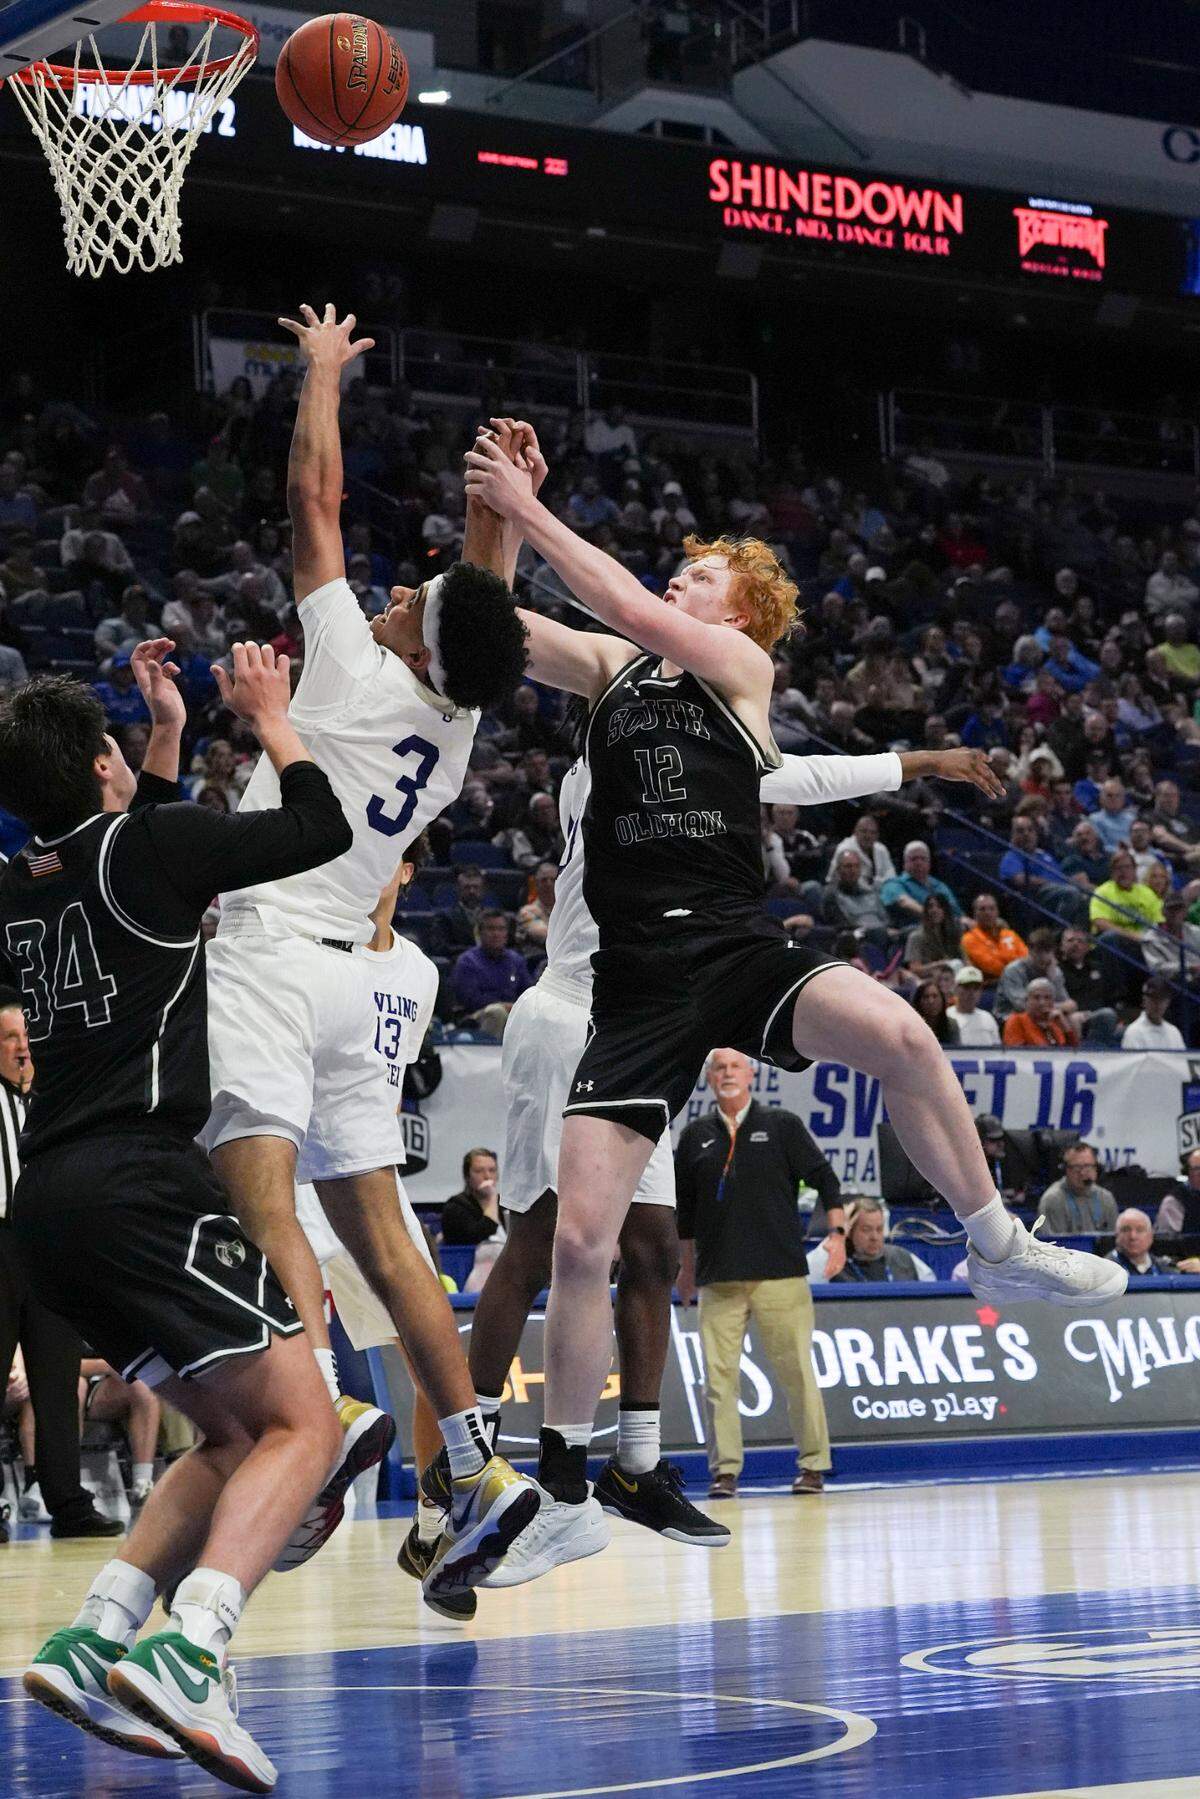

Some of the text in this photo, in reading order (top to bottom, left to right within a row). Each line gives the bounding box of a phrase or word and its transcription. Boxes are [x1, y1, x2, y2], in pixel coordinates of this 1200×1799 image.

[218, 97, 236, 137] 2
[709, 159, 963, 234] SHINEDOWN
[607, 700, 710, 747] SOUTH
[366, 734, 439, 837] 3
[634, 745, 687, 803] 12
[615, 811, 727, 845] OLDHAM
[5, 901, 117, 1042] 34
[853, 1396, 927, 1419] Come
